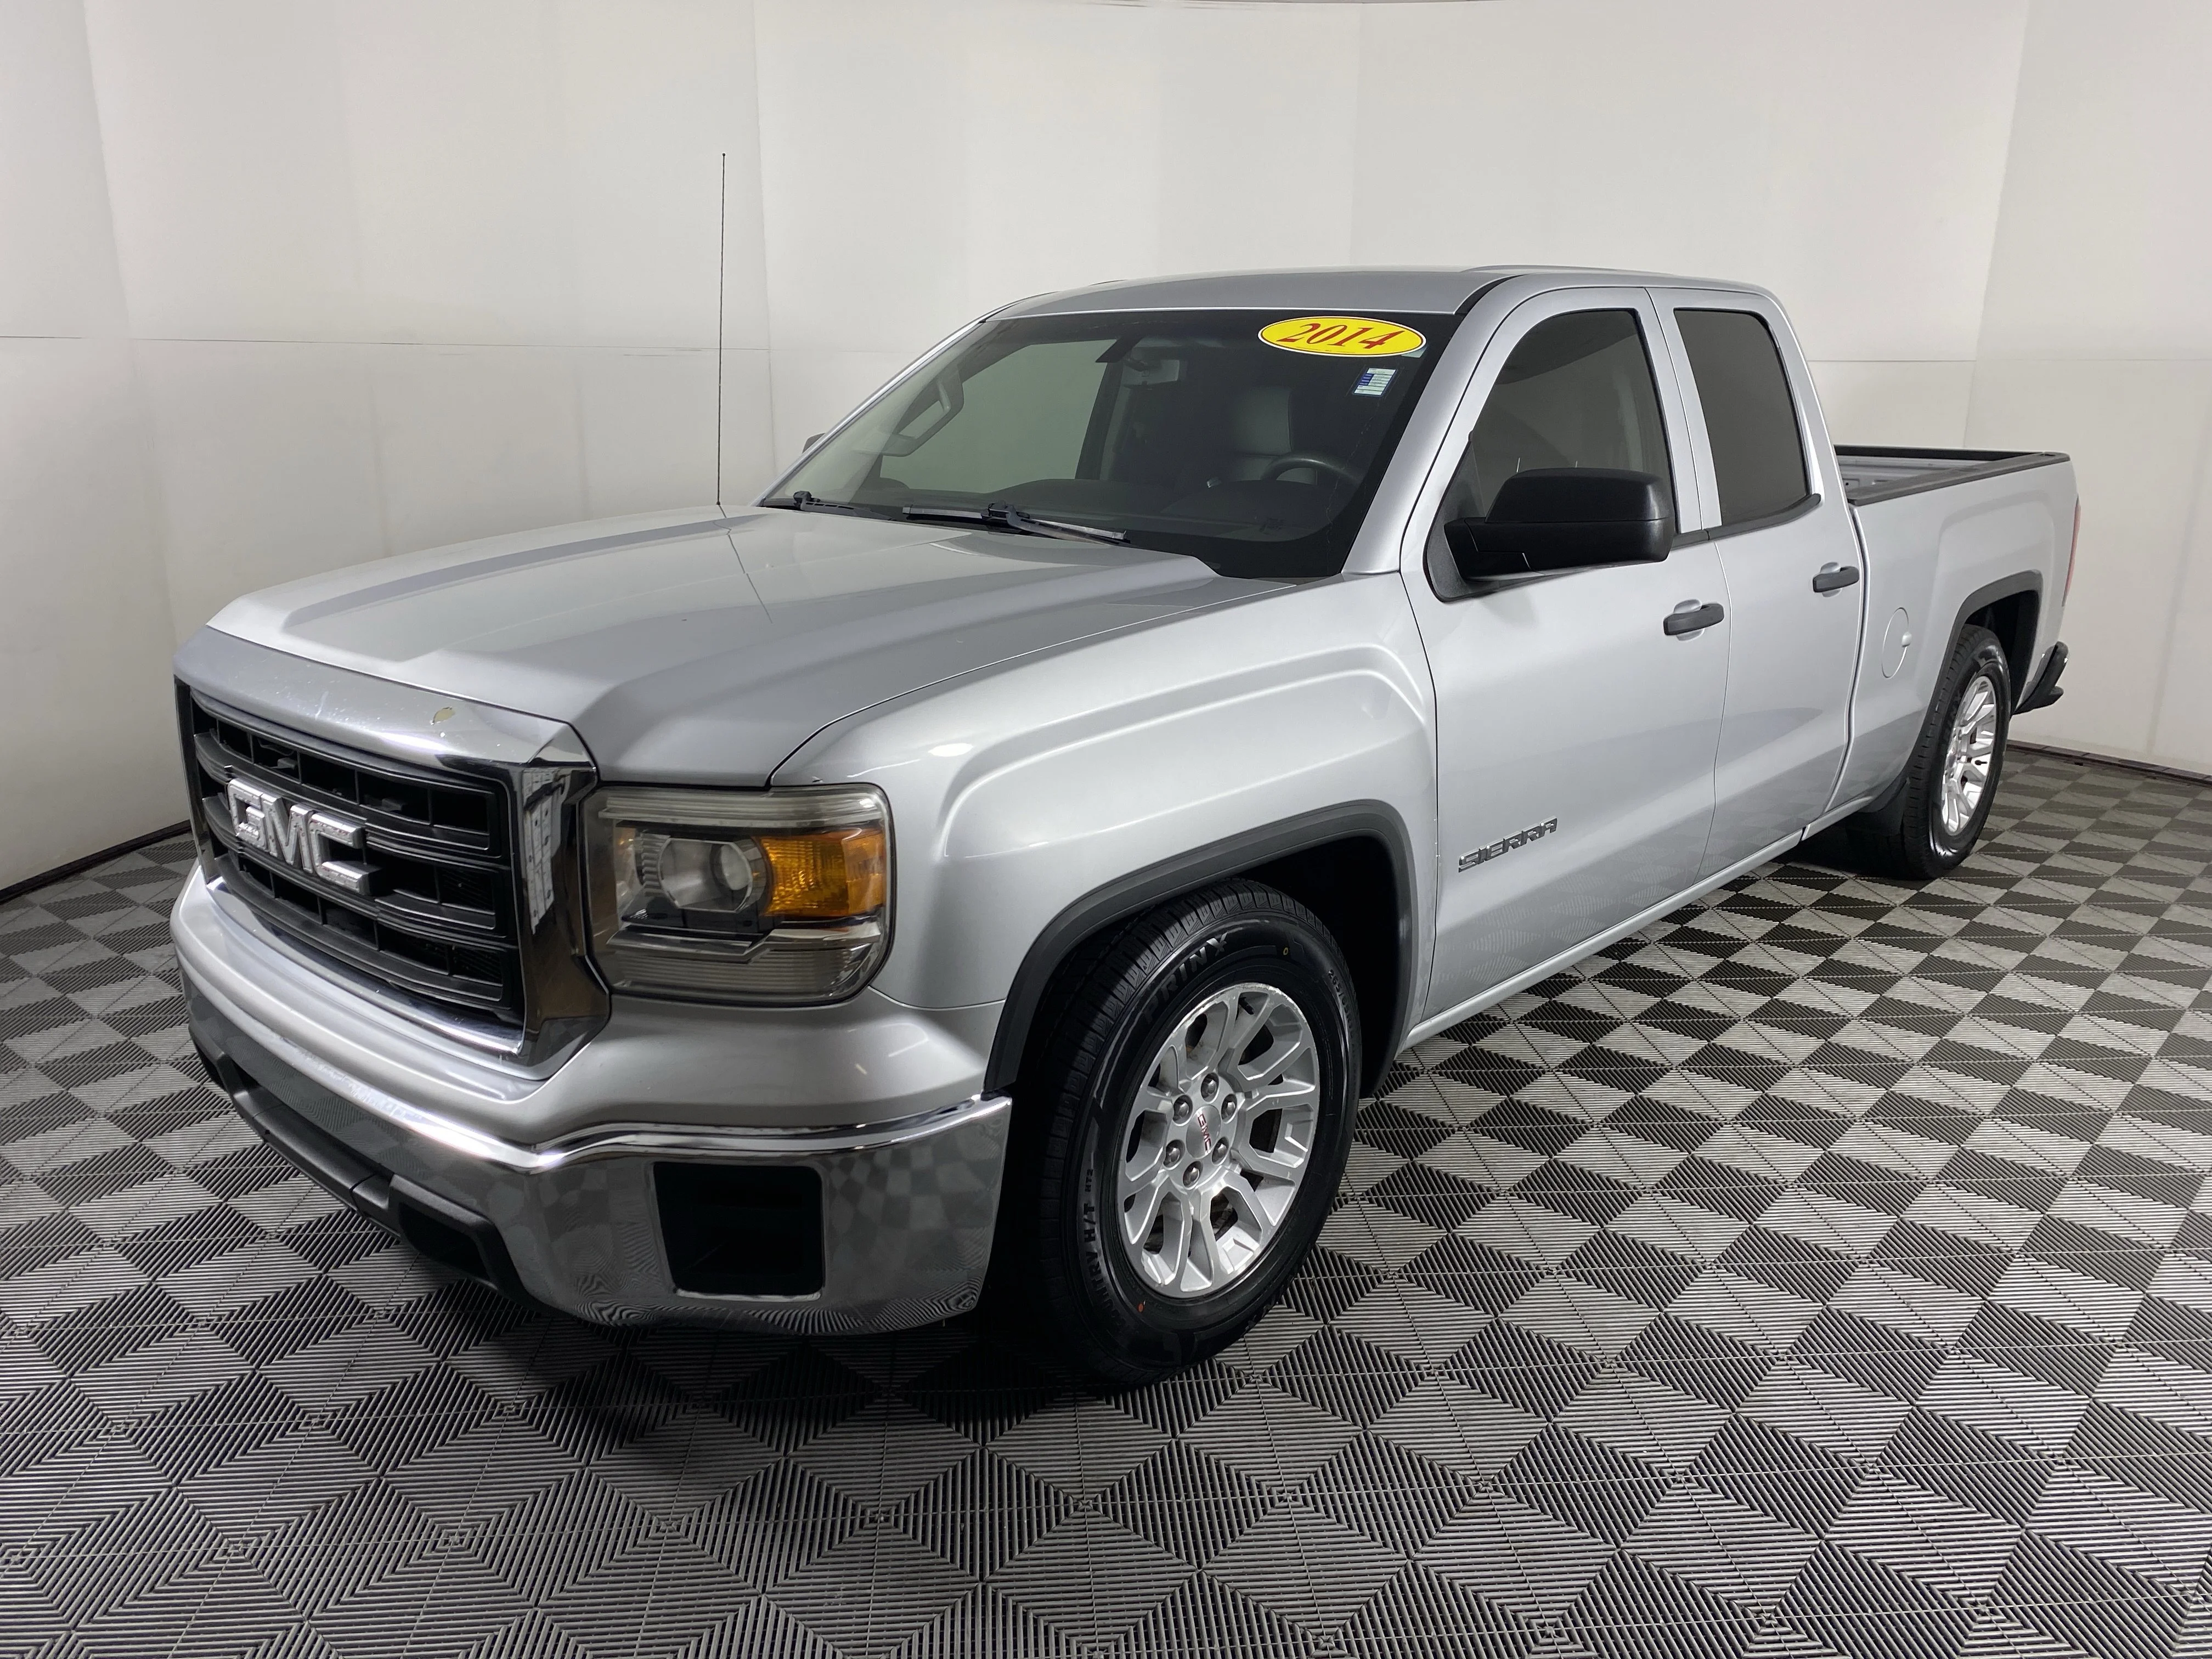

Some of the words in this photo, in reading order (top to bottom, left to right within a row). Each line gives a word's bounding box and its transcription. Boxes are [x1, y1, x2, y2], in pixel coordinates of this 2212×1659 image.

[1276, 323, 1406, 349] 2014
[227, 778, 369, 896] GMC
[1458, 816, 1558, 873] SIERRA
[1144, 932, 1228, 1024] PRINX
[1197, 1113, 1212, 1152] GMC
[1084, 1168, 1094, 1193] HT2
[1083, 1203, 1096, 1243] H/T
